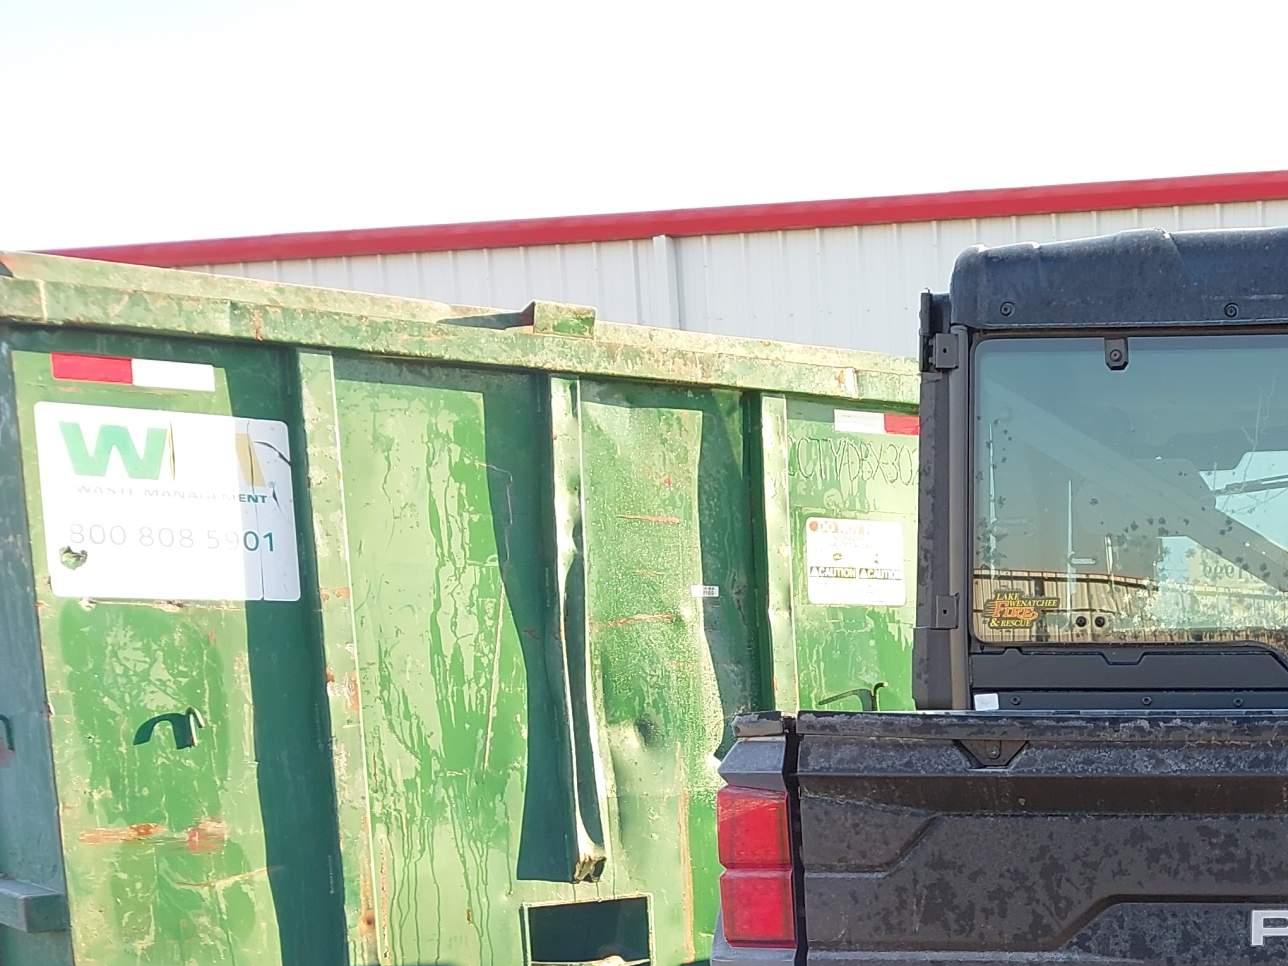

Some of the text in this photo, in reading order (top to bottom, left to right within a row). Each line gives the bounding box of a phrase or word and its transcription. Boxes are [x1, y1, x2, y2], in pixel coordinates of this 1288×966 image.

[138, 526, 195, 549] 808
[819, 566, 856, 578] CAUTION
[867, 568, 902, 579] CAUTIO
[996, 593, 1020, 601] LAKE
[1009, 599, 1058, 607] WENATCHEE
[1000, 619, 1033, 627] RESCUE
